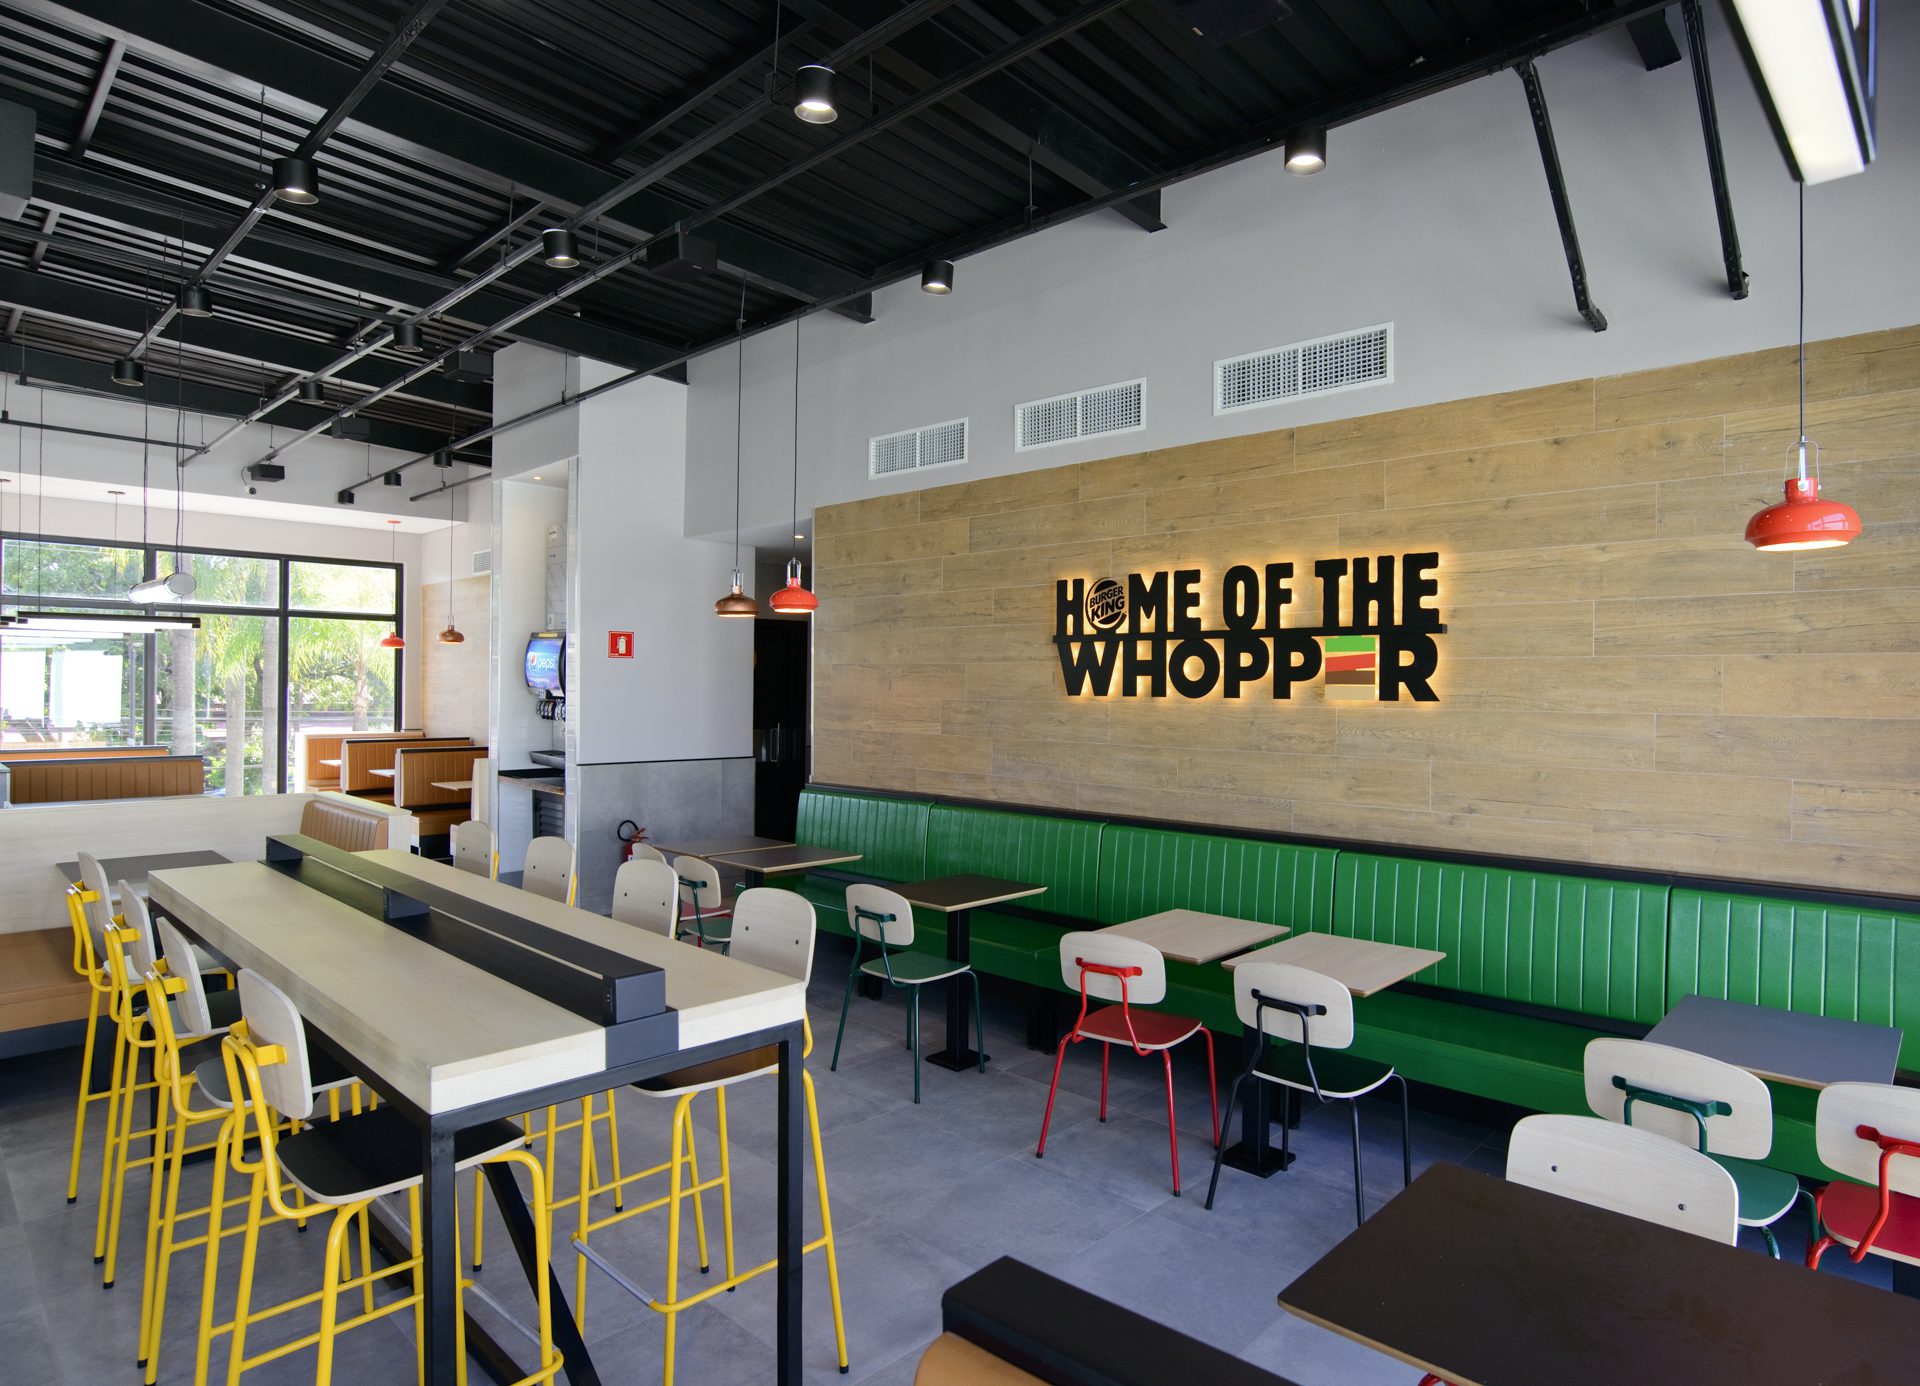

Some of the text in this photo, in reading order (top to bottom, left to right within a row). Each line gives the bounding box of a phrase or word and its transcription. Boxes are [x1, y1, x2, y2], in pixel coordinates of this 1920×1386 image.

[1090, 585, 1124, 609] BURGER
[1222, 562, 1294, 632] OF
[1314, 551, 1440, 628] THE
[1091, 596, 1125, 622] KING
[537, 655, 556, 671] pepsi
